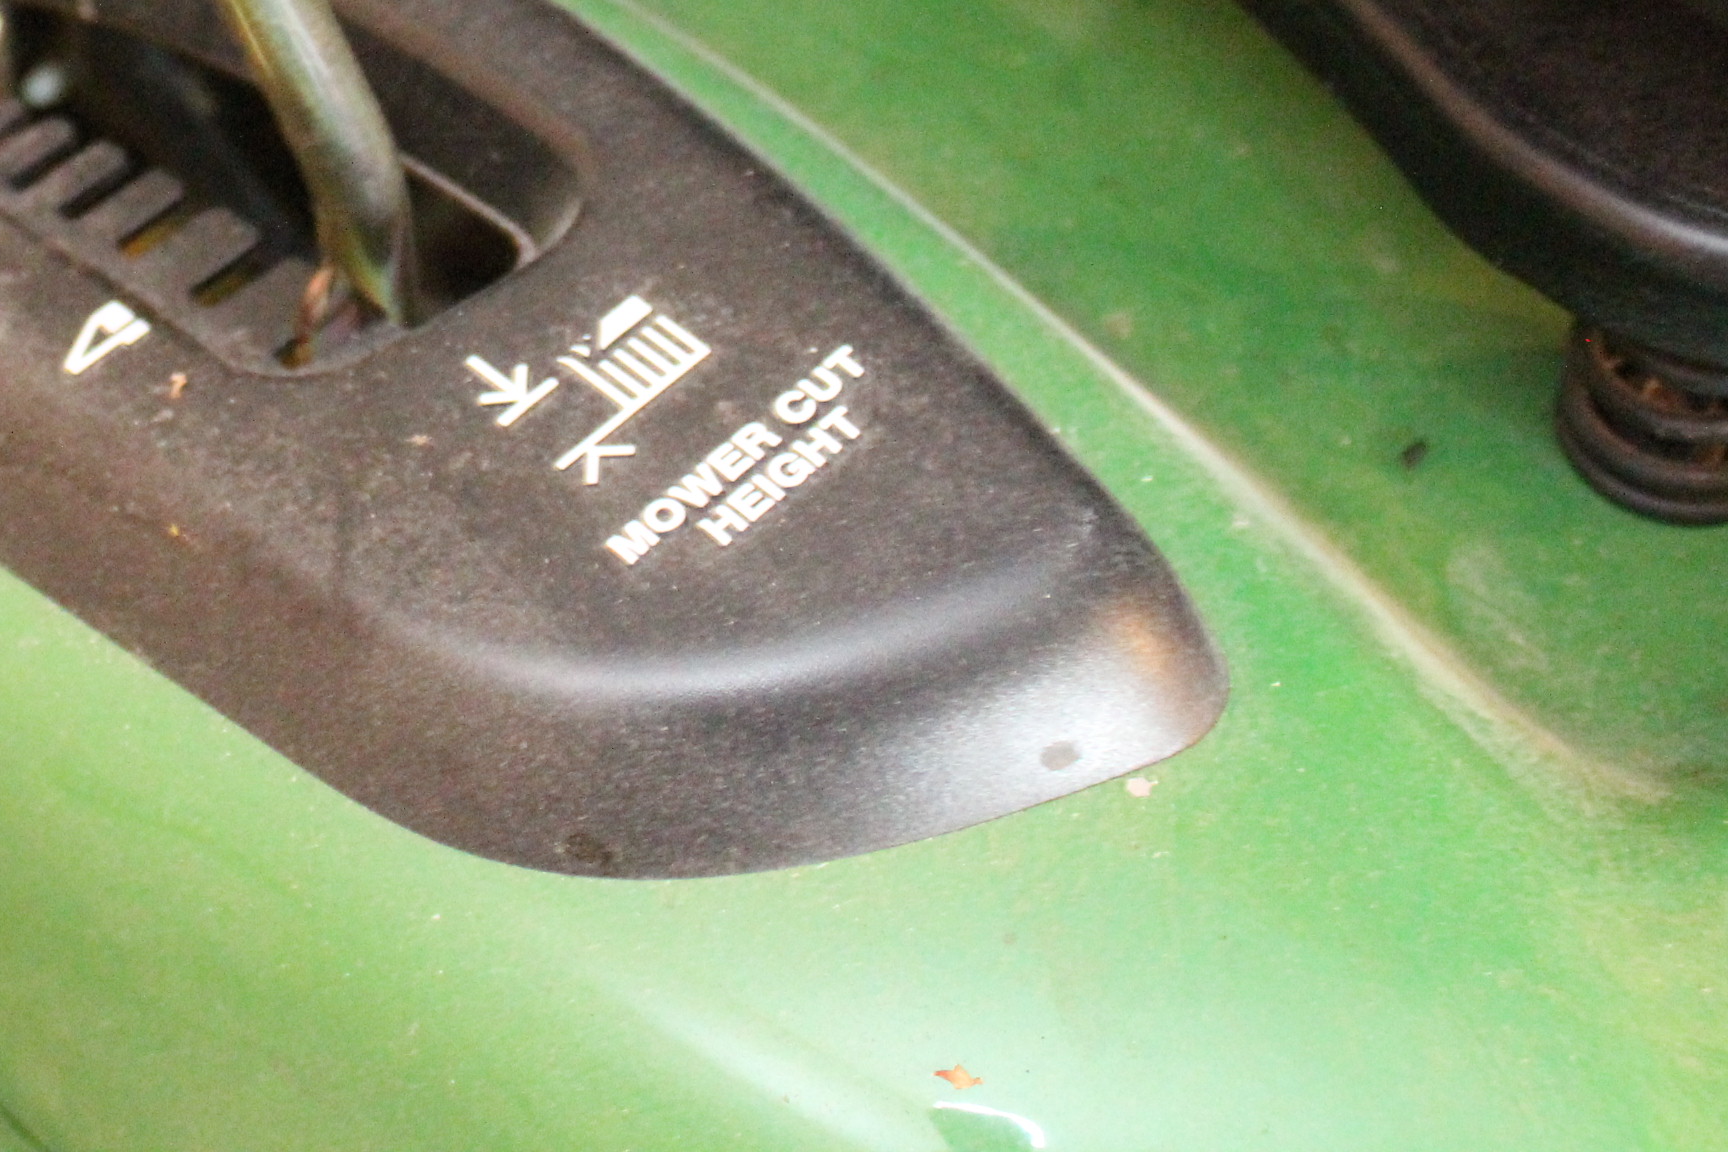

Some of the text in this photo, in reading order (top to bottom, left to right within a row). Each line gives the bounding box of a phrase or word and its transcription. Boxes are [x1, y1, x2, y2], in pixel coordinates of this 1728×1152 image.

[61, 300, 151, 378] 4
[604, 344, 865, 565] MOWER CUT
[696, 405, 861, 547] HEIGHT
